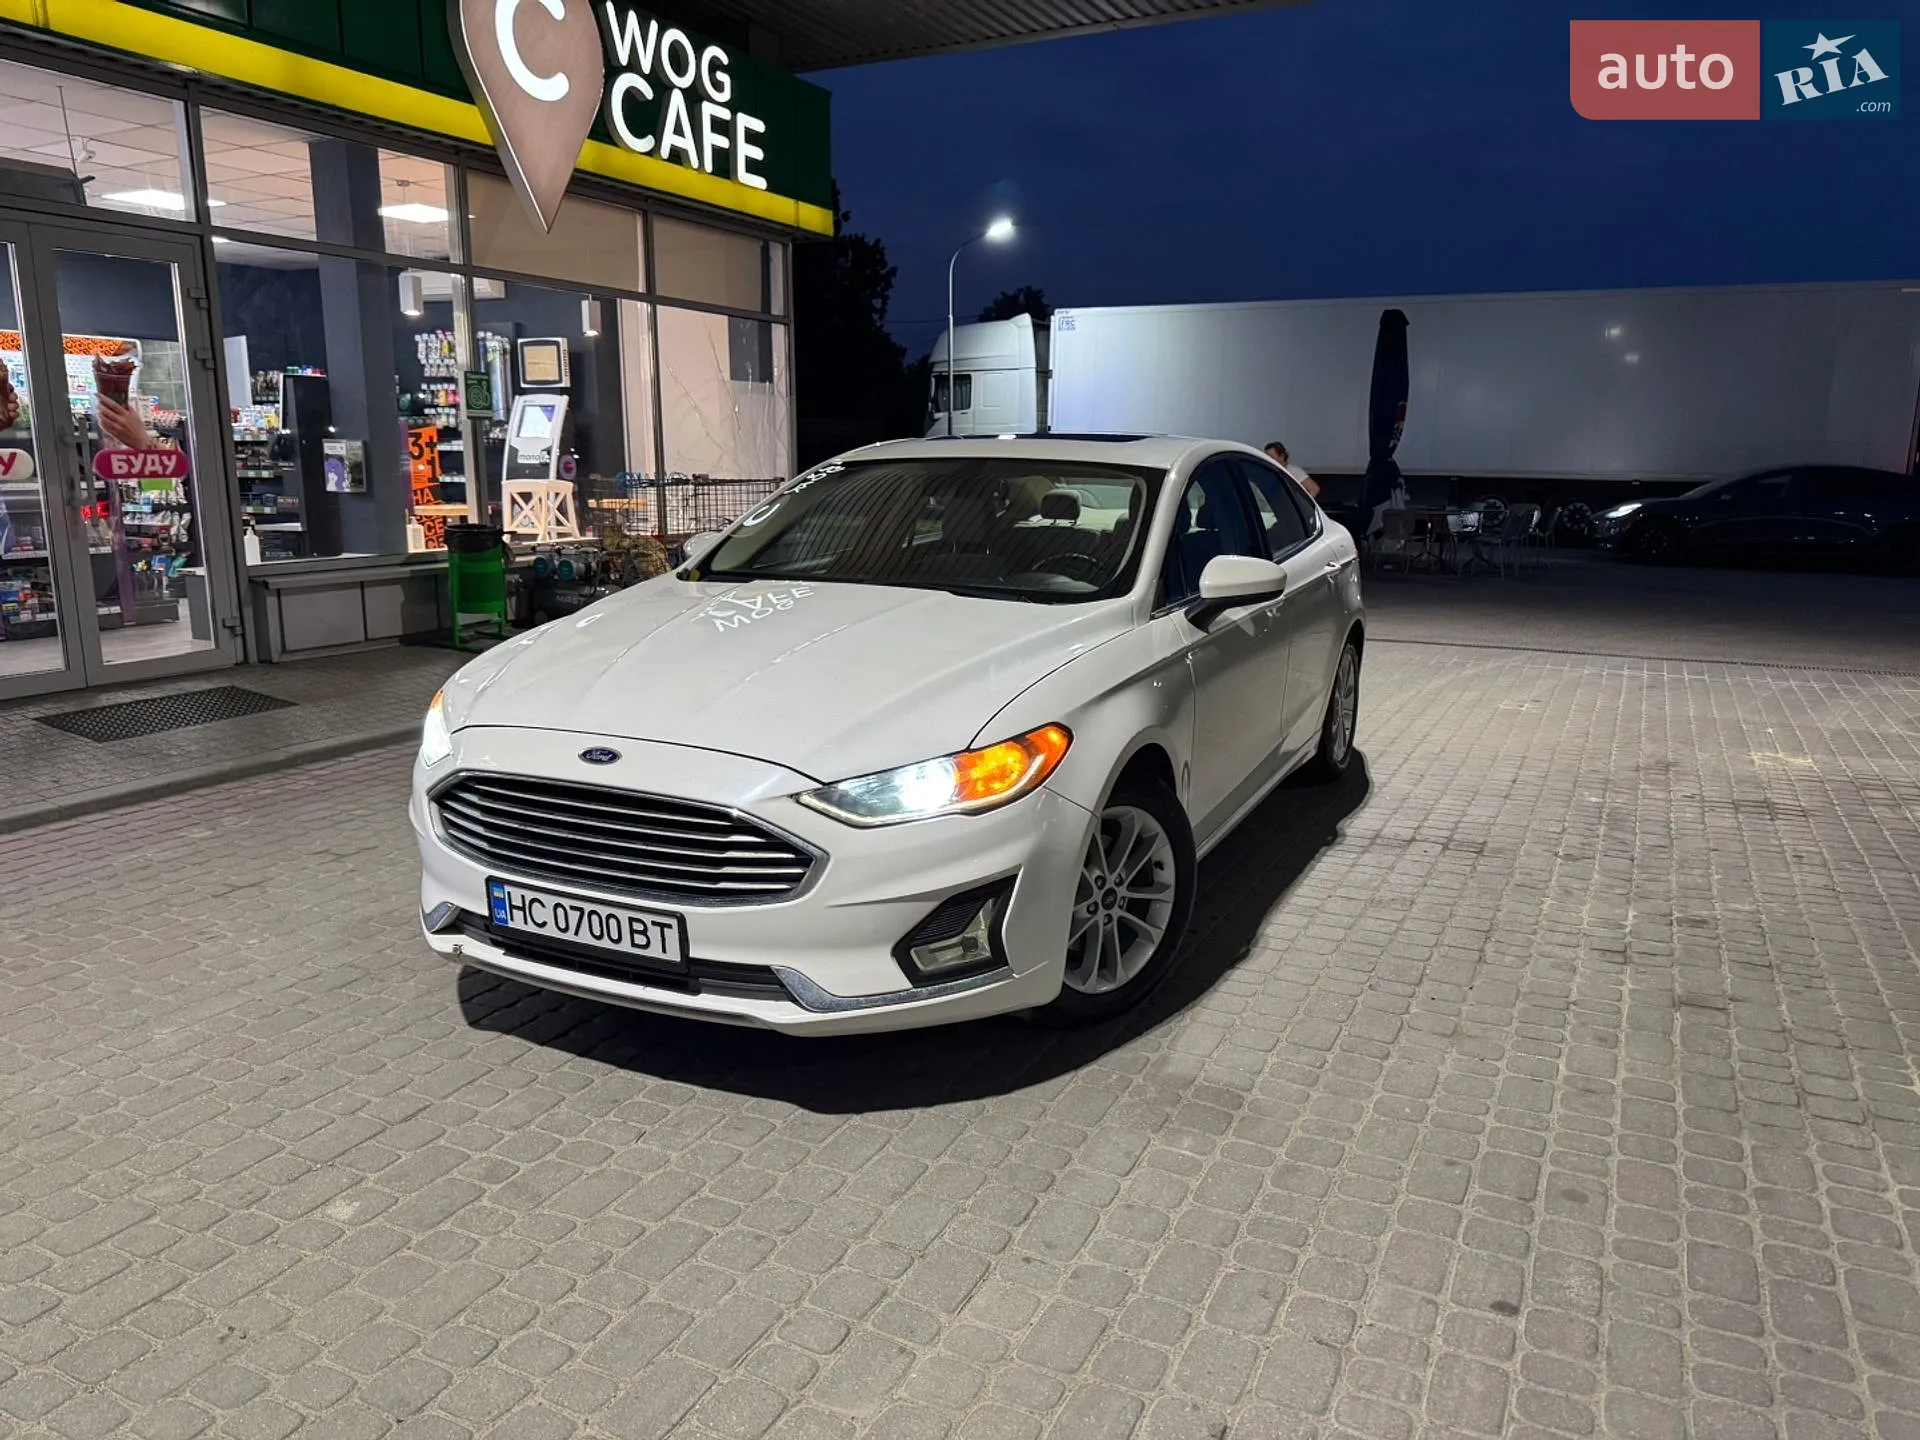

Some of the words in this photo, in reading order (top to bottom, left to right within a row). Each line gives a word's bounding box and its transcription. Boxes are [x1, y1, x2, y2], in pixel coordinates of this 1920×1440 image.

[495, 0, 570, 102] C
[605, 0, 731, 103] WOG
[611, 72, 767, 190] CAFE
[110, 453, 178, 476] БУДУ
[494, 907, 506, 920] UA
[507, 890, 547, 928] HC
[553, 902, 622, 945] 0700
[628, 916, 673, 954] BT
